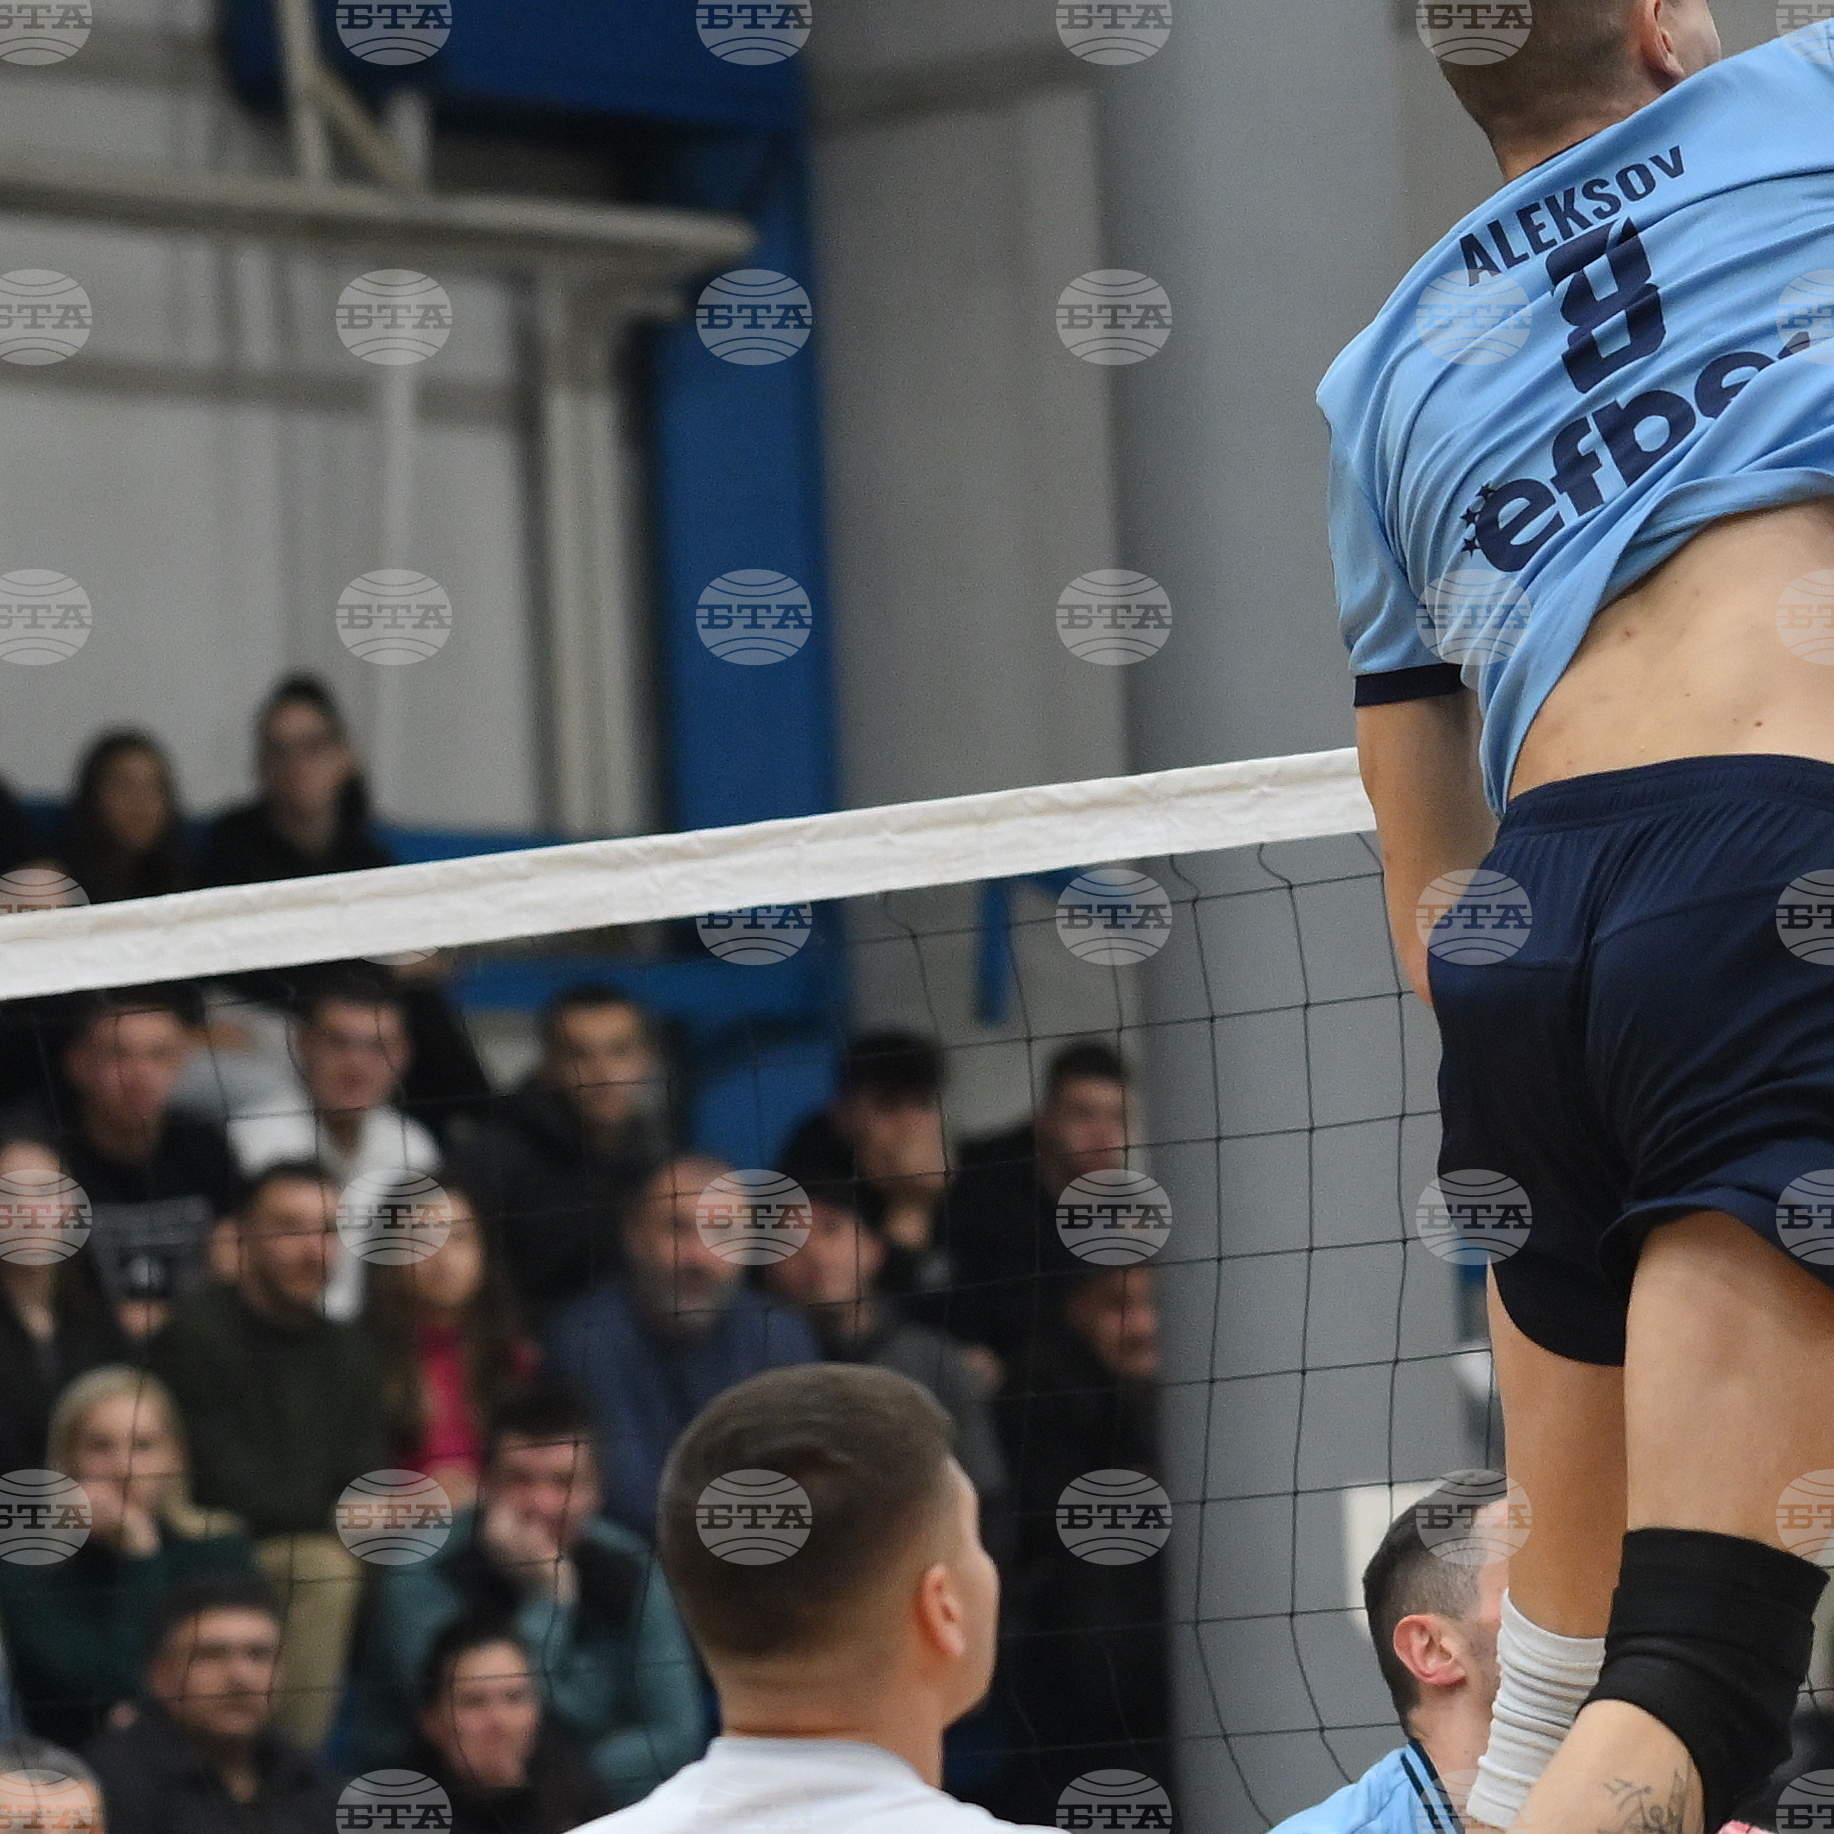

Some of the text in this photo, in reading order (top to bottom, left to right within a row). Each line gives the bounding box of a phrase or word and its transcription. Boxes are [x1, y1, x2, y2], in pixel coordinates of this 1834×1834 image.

[1459, 145, 1687, 287] ALEKSOV
[1545, 215, 1667, 395] 8
[1475, 330, 1812, 573] efbe
